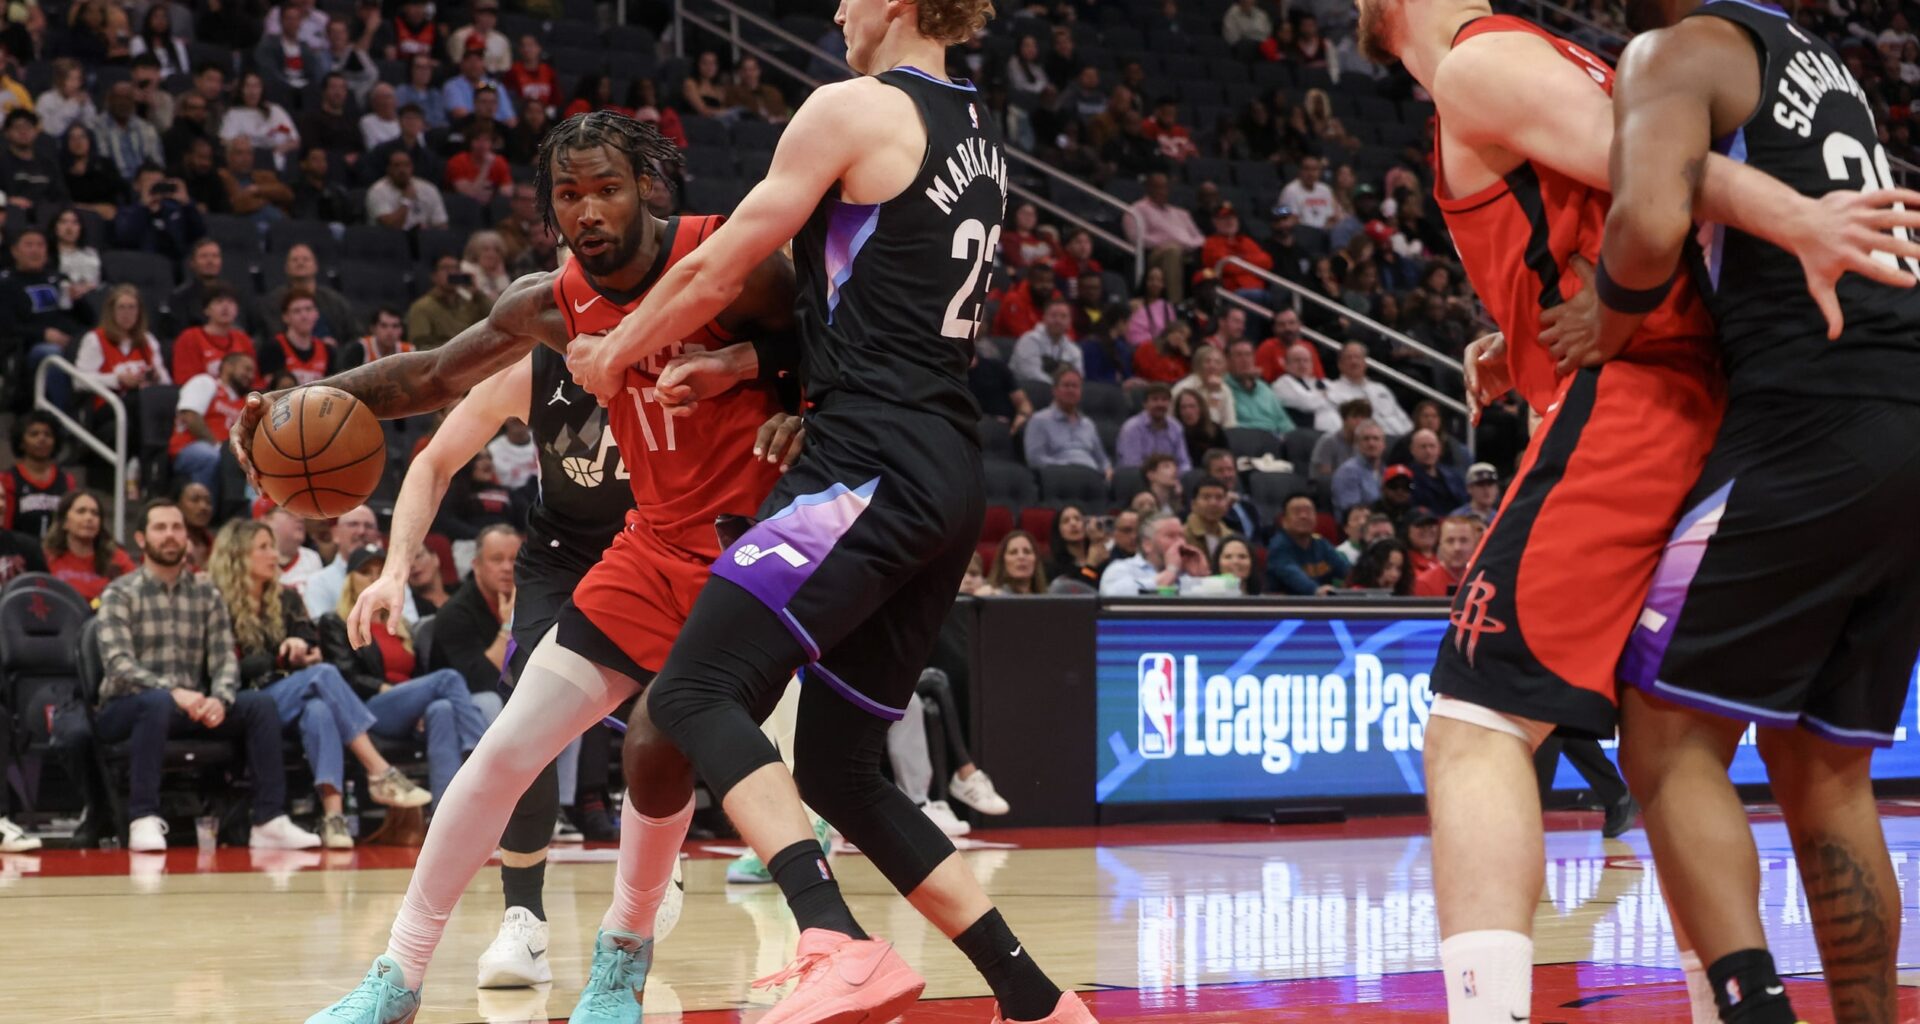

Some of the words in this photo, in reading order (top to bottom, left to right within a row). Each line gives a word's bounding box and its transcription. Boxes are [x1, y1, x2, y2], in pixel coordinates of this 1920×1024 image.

[1773, 51, 1878, 138] SENSABA
[925, 137, 1008, 220] MARKKAN
[626, 387, 676, 451] 17
[1184, 654, 1347, 774] League
[1355, 653, 1433, 752] Pas
